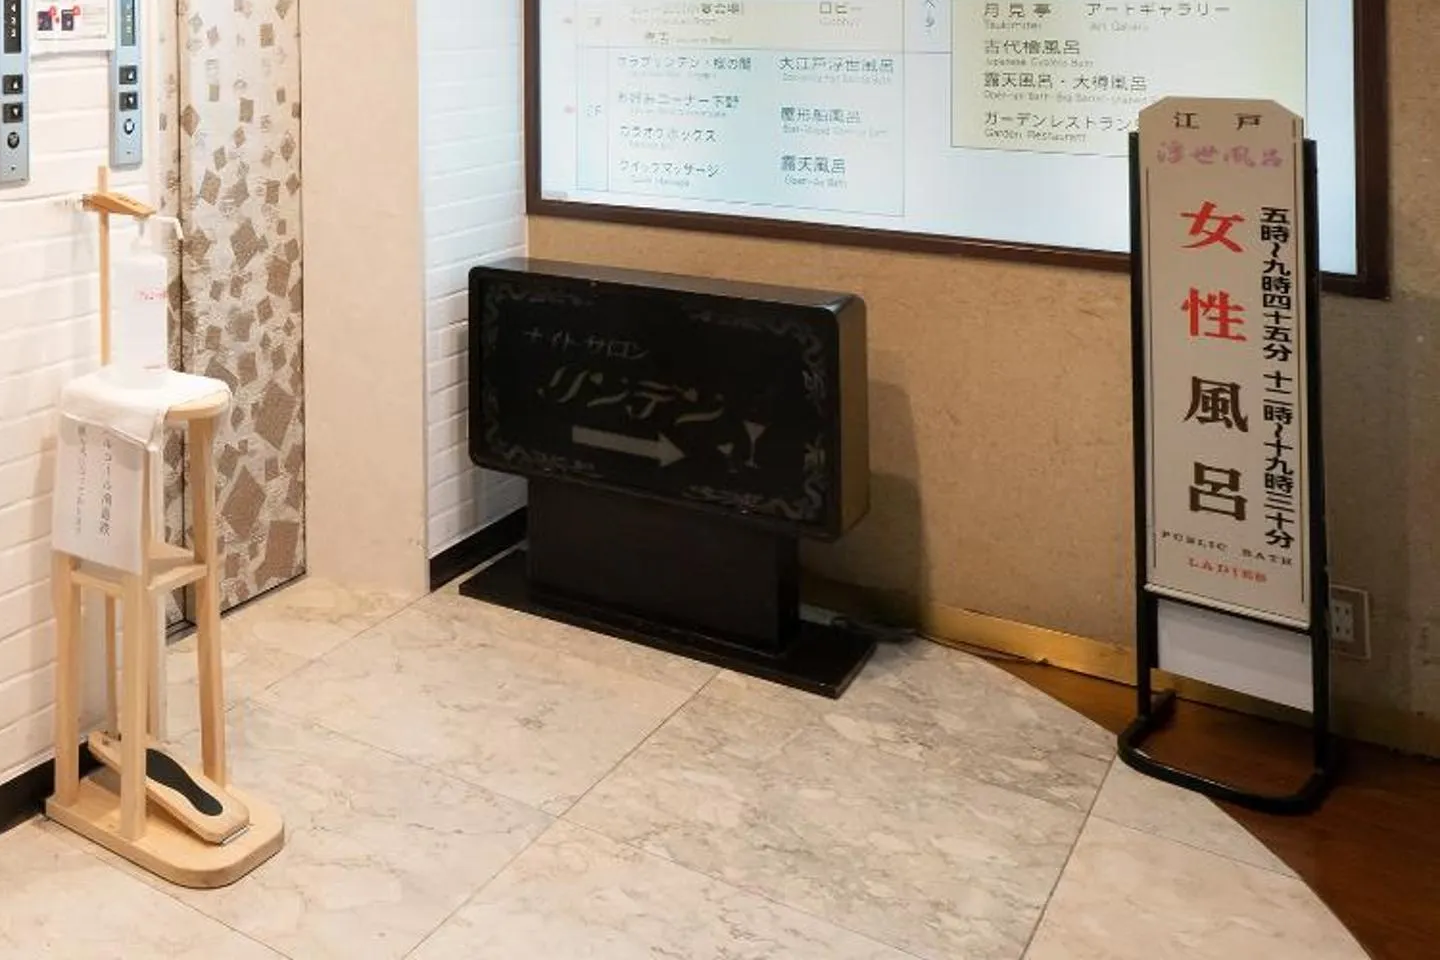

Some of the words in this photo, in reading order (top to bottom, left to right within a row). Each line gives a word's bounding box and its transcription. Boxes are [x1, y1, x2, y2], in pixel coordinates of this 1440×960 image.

[1086, 3, 1230, 18] アートギャラリー
[1174, 111, 1262, 131] 江戸
[1162, 530, 1227, 551] PUBLIC
[1242, 548, 1292, 566] BATH
[1189, 557, 1267, 582] LADIES
